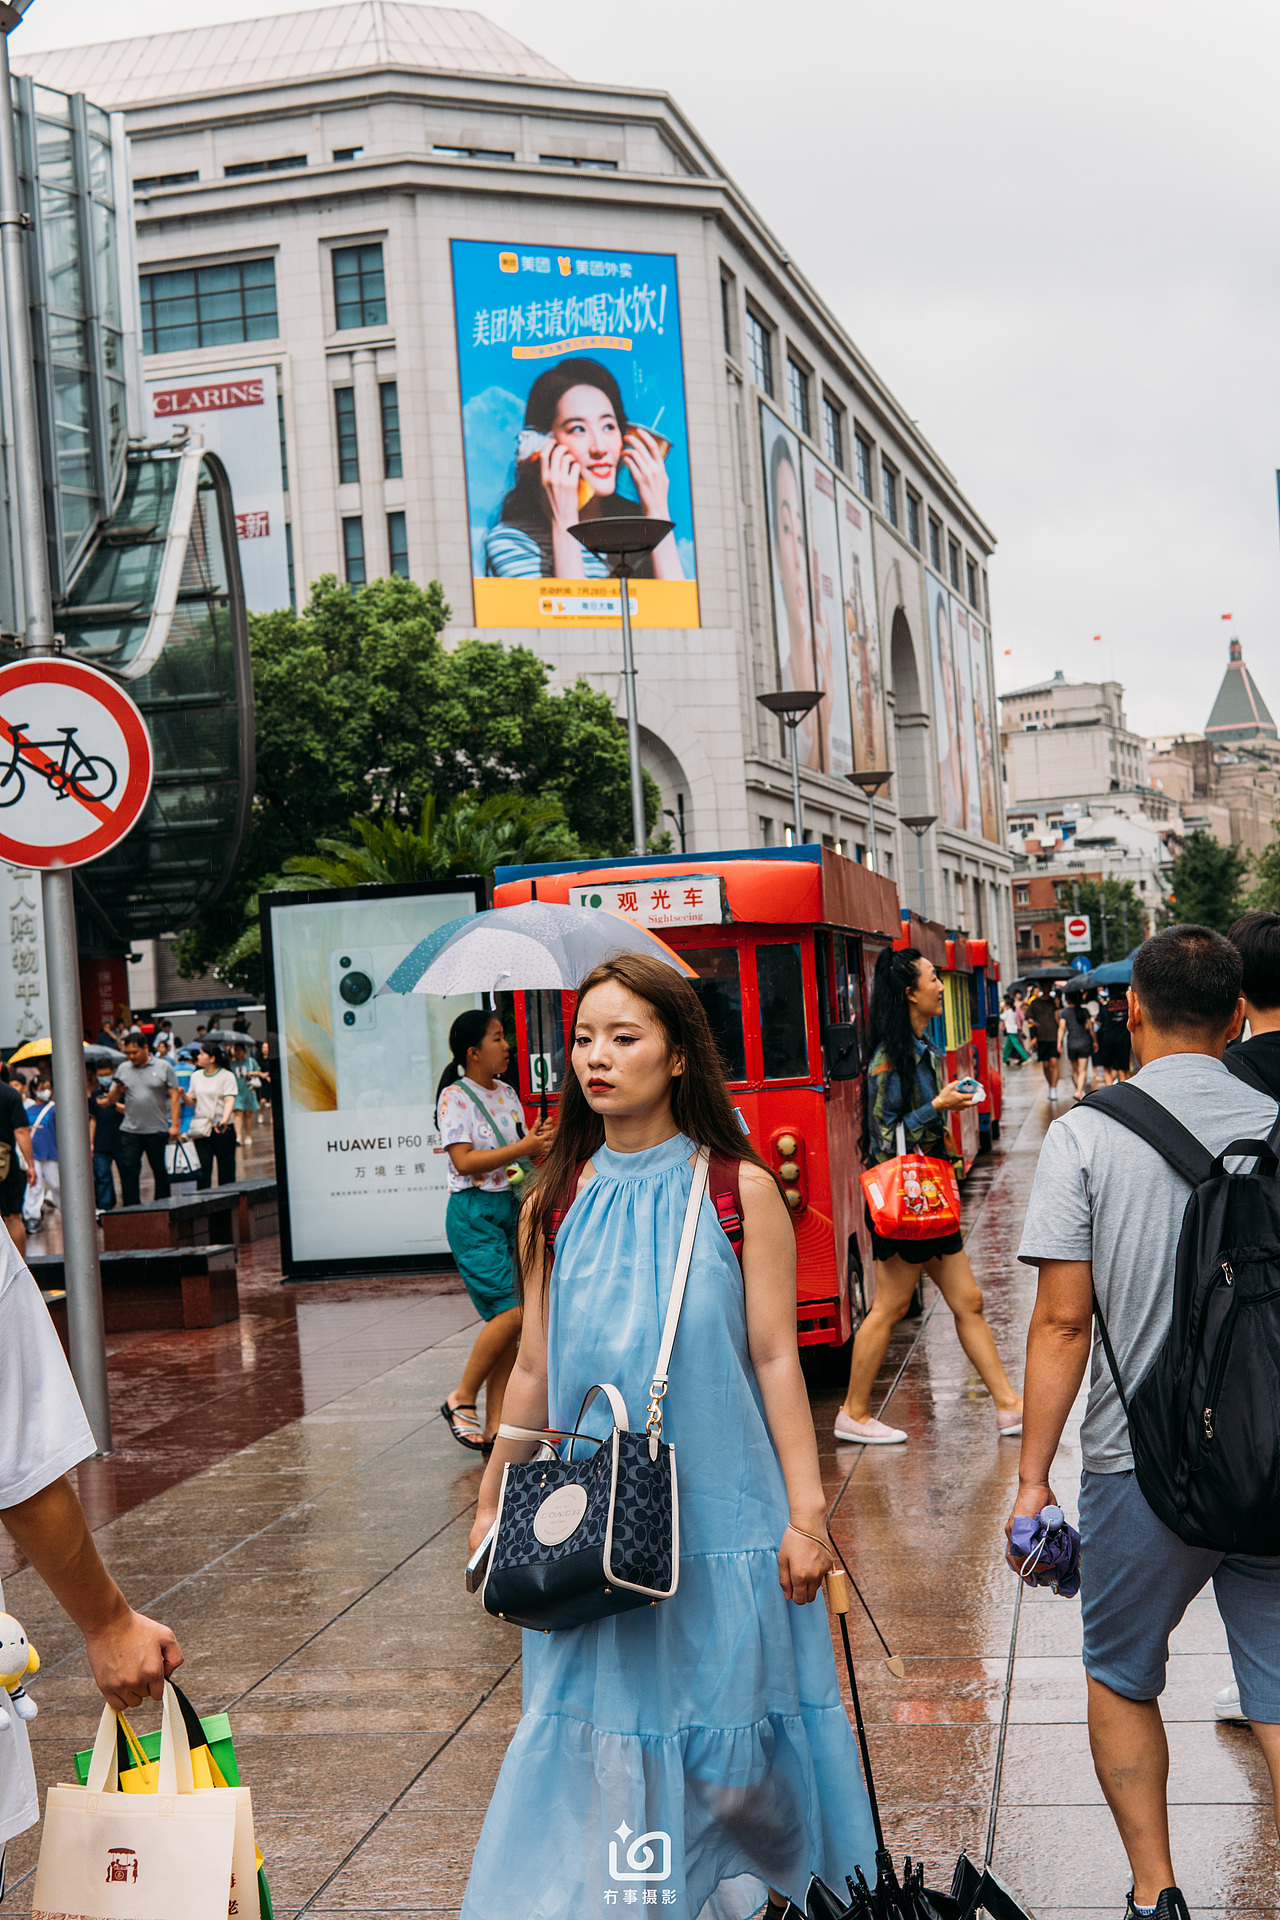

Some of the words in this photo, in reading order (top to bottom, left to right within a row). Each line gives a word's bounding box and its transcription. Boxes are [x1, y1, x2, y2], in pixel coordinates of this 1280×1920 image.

[521, 256, 551, 273] 美团
[575, 260, 632, 278] 美团外卖
[153, 382, 264, 413] CLARINS
[617, 887, 704, 912] 观光车
[648, 913, 704, 924] Sightseeing
[534, 1056, 549, 1089] 9
[327, 1137, 392, 1152] HUAWEI
[397, 1135, 422, 1148] P60
[426, 1134, 442, 1147] 系
[354, 1162, 426, 1178] 万境生辉
[540, 1509, 581, 1519] COACH
